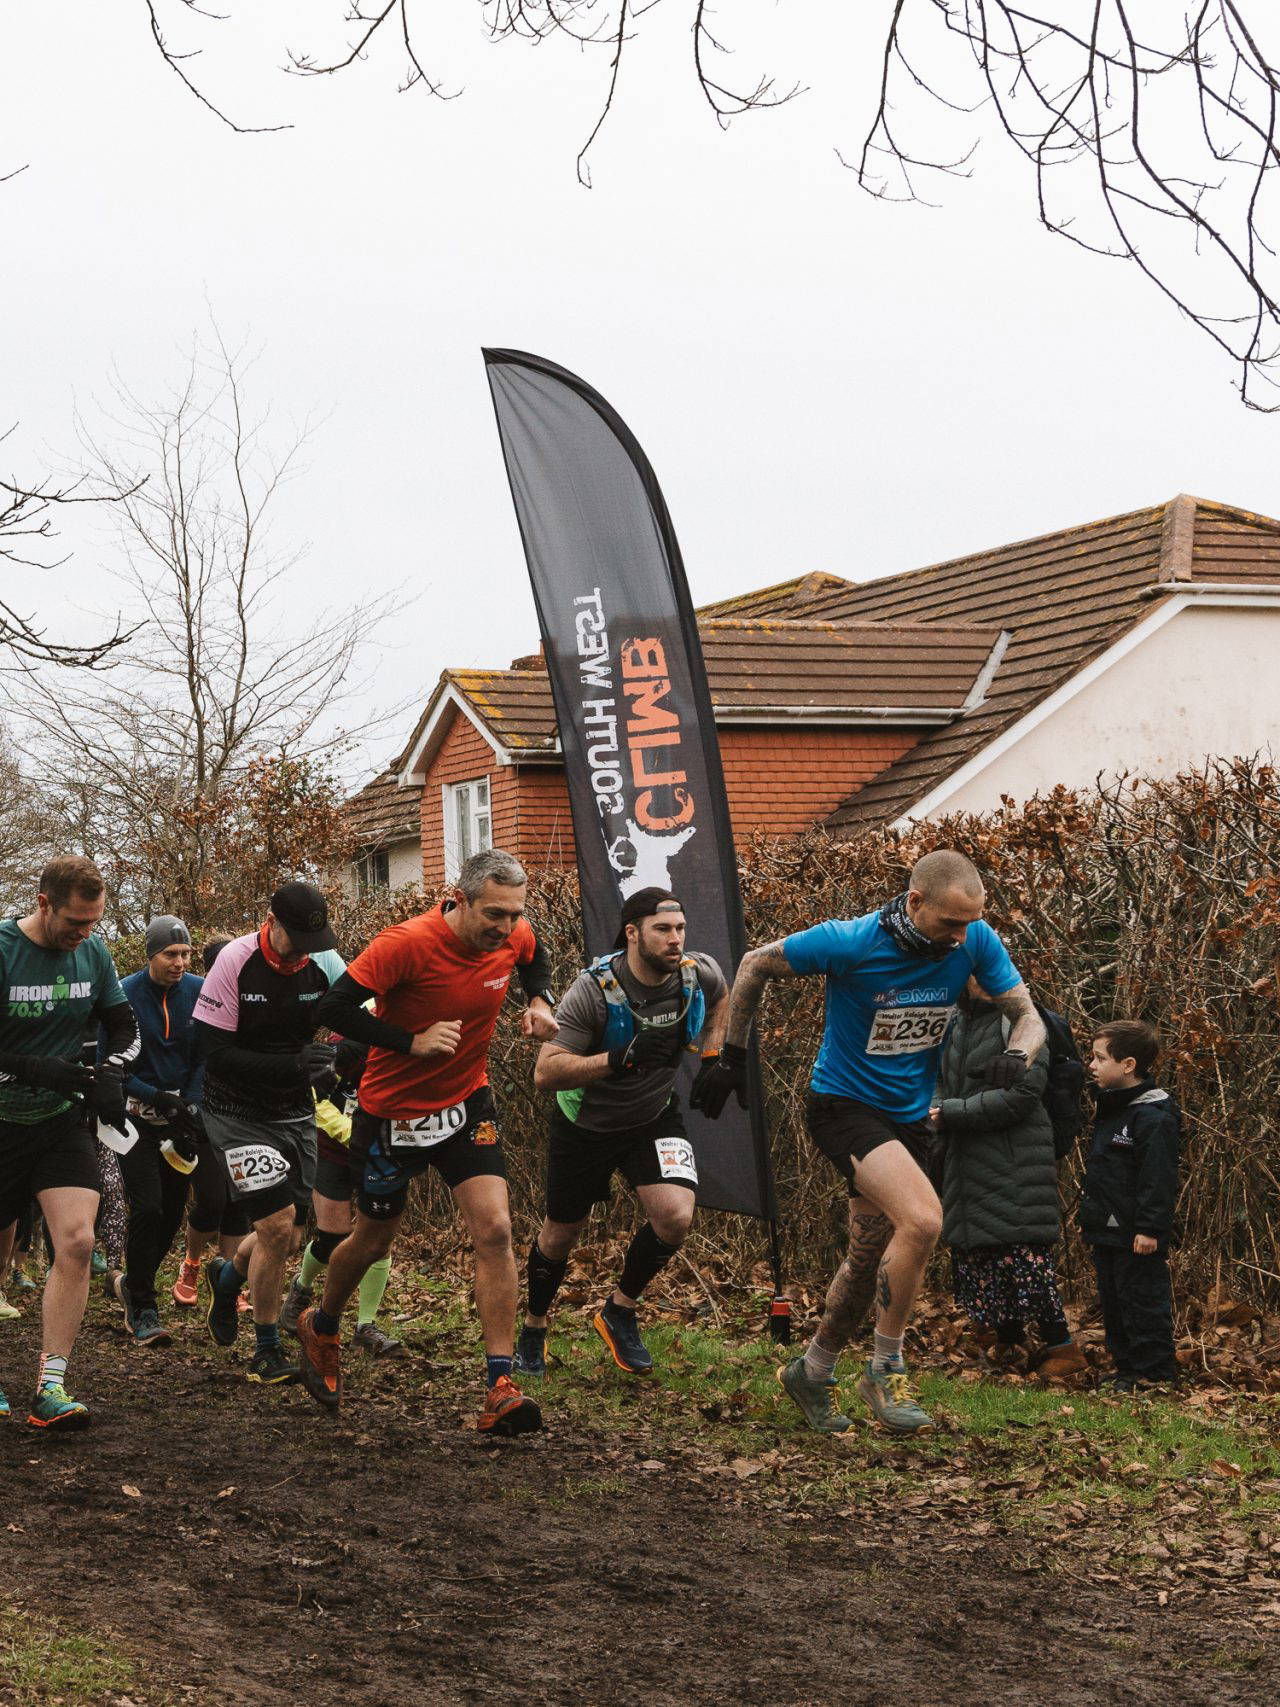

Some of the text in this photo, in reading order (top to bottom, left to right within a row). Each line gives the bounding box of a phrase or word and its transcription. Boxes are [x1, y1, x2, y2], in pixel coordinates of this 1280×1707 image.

[9, 981, 91, 1001] IRONMAN
[896, 988, 948, 1003] OMM
[8, 1001, 43, 1017] 70.3
[653, 1011, 677, 1024] OUTLAW
[904, 1011, 927, 1019] Raleigh
[894, 1018, 947, 1040] 236
[414, 1107, 463, 1131] 210
[244, 1155, 286, 1178] 239
